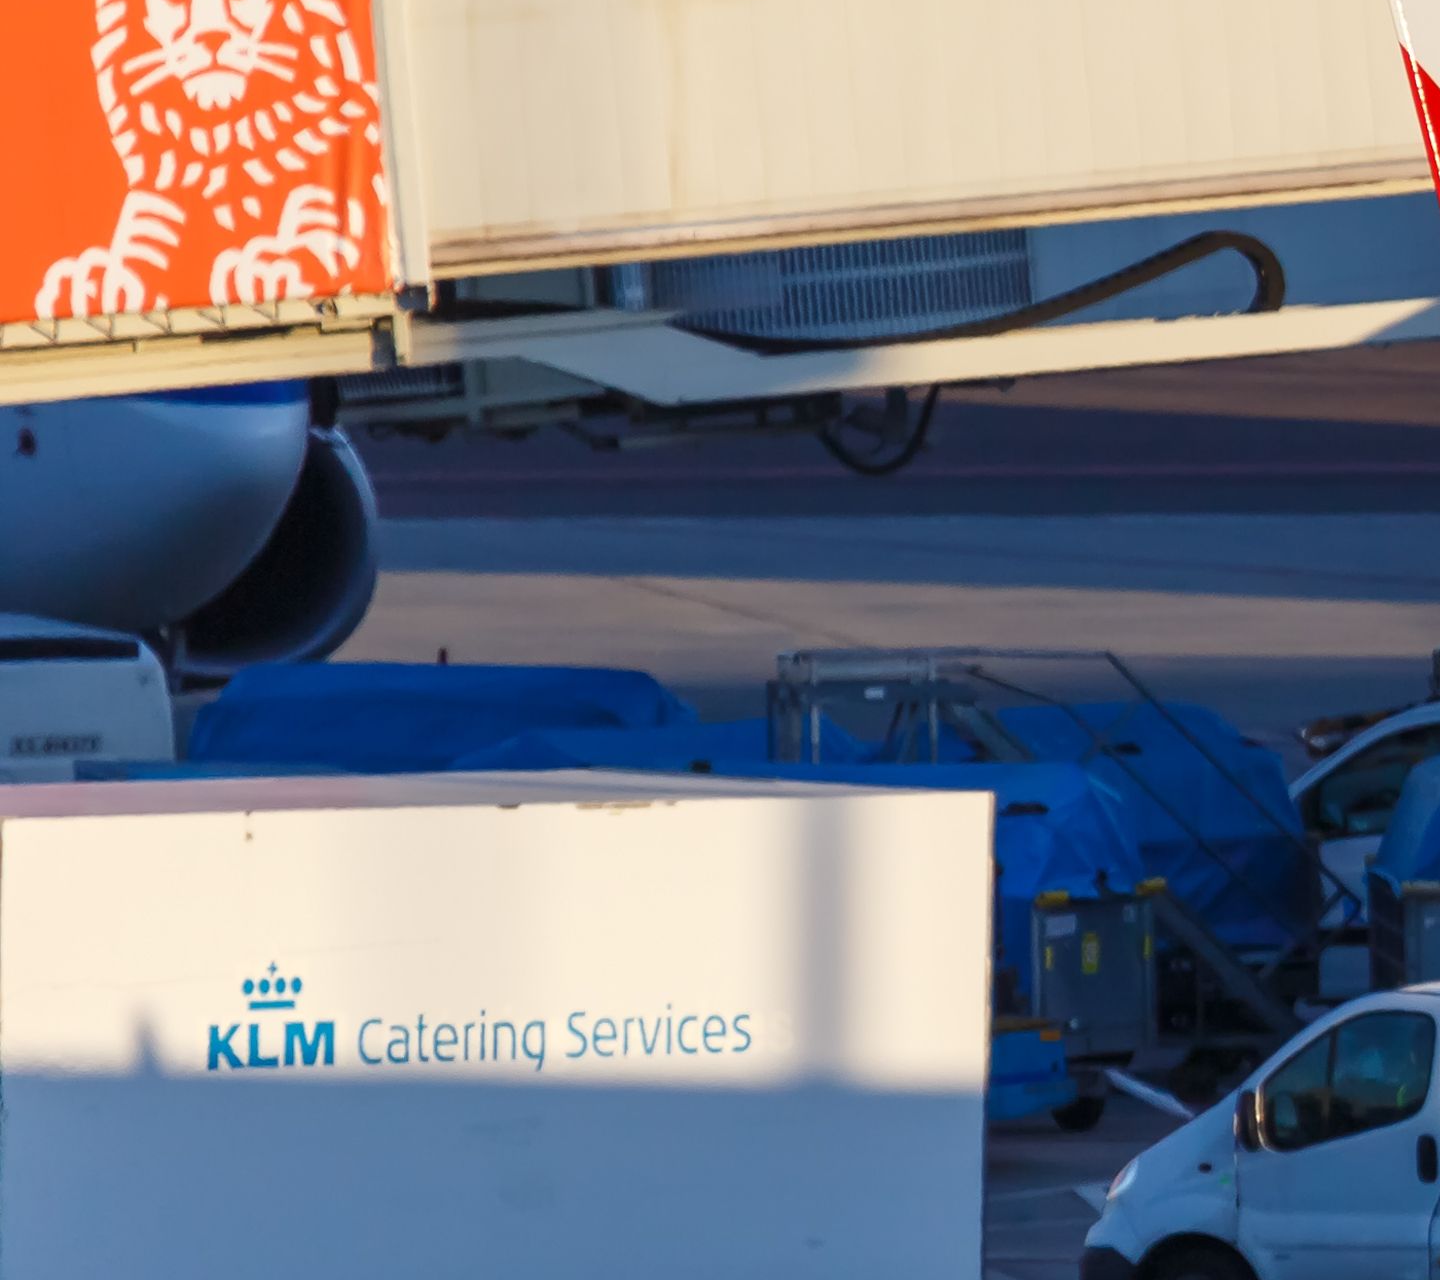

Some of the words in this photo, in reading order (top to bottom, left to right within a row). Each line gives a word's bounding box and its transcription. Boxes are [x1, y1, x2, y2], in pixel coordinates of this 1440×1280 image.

[206, 1020, 335, 1070] KLM
[357, 1010, 546, 1072] Catering
[565, 1003, 752, 1059] Services
